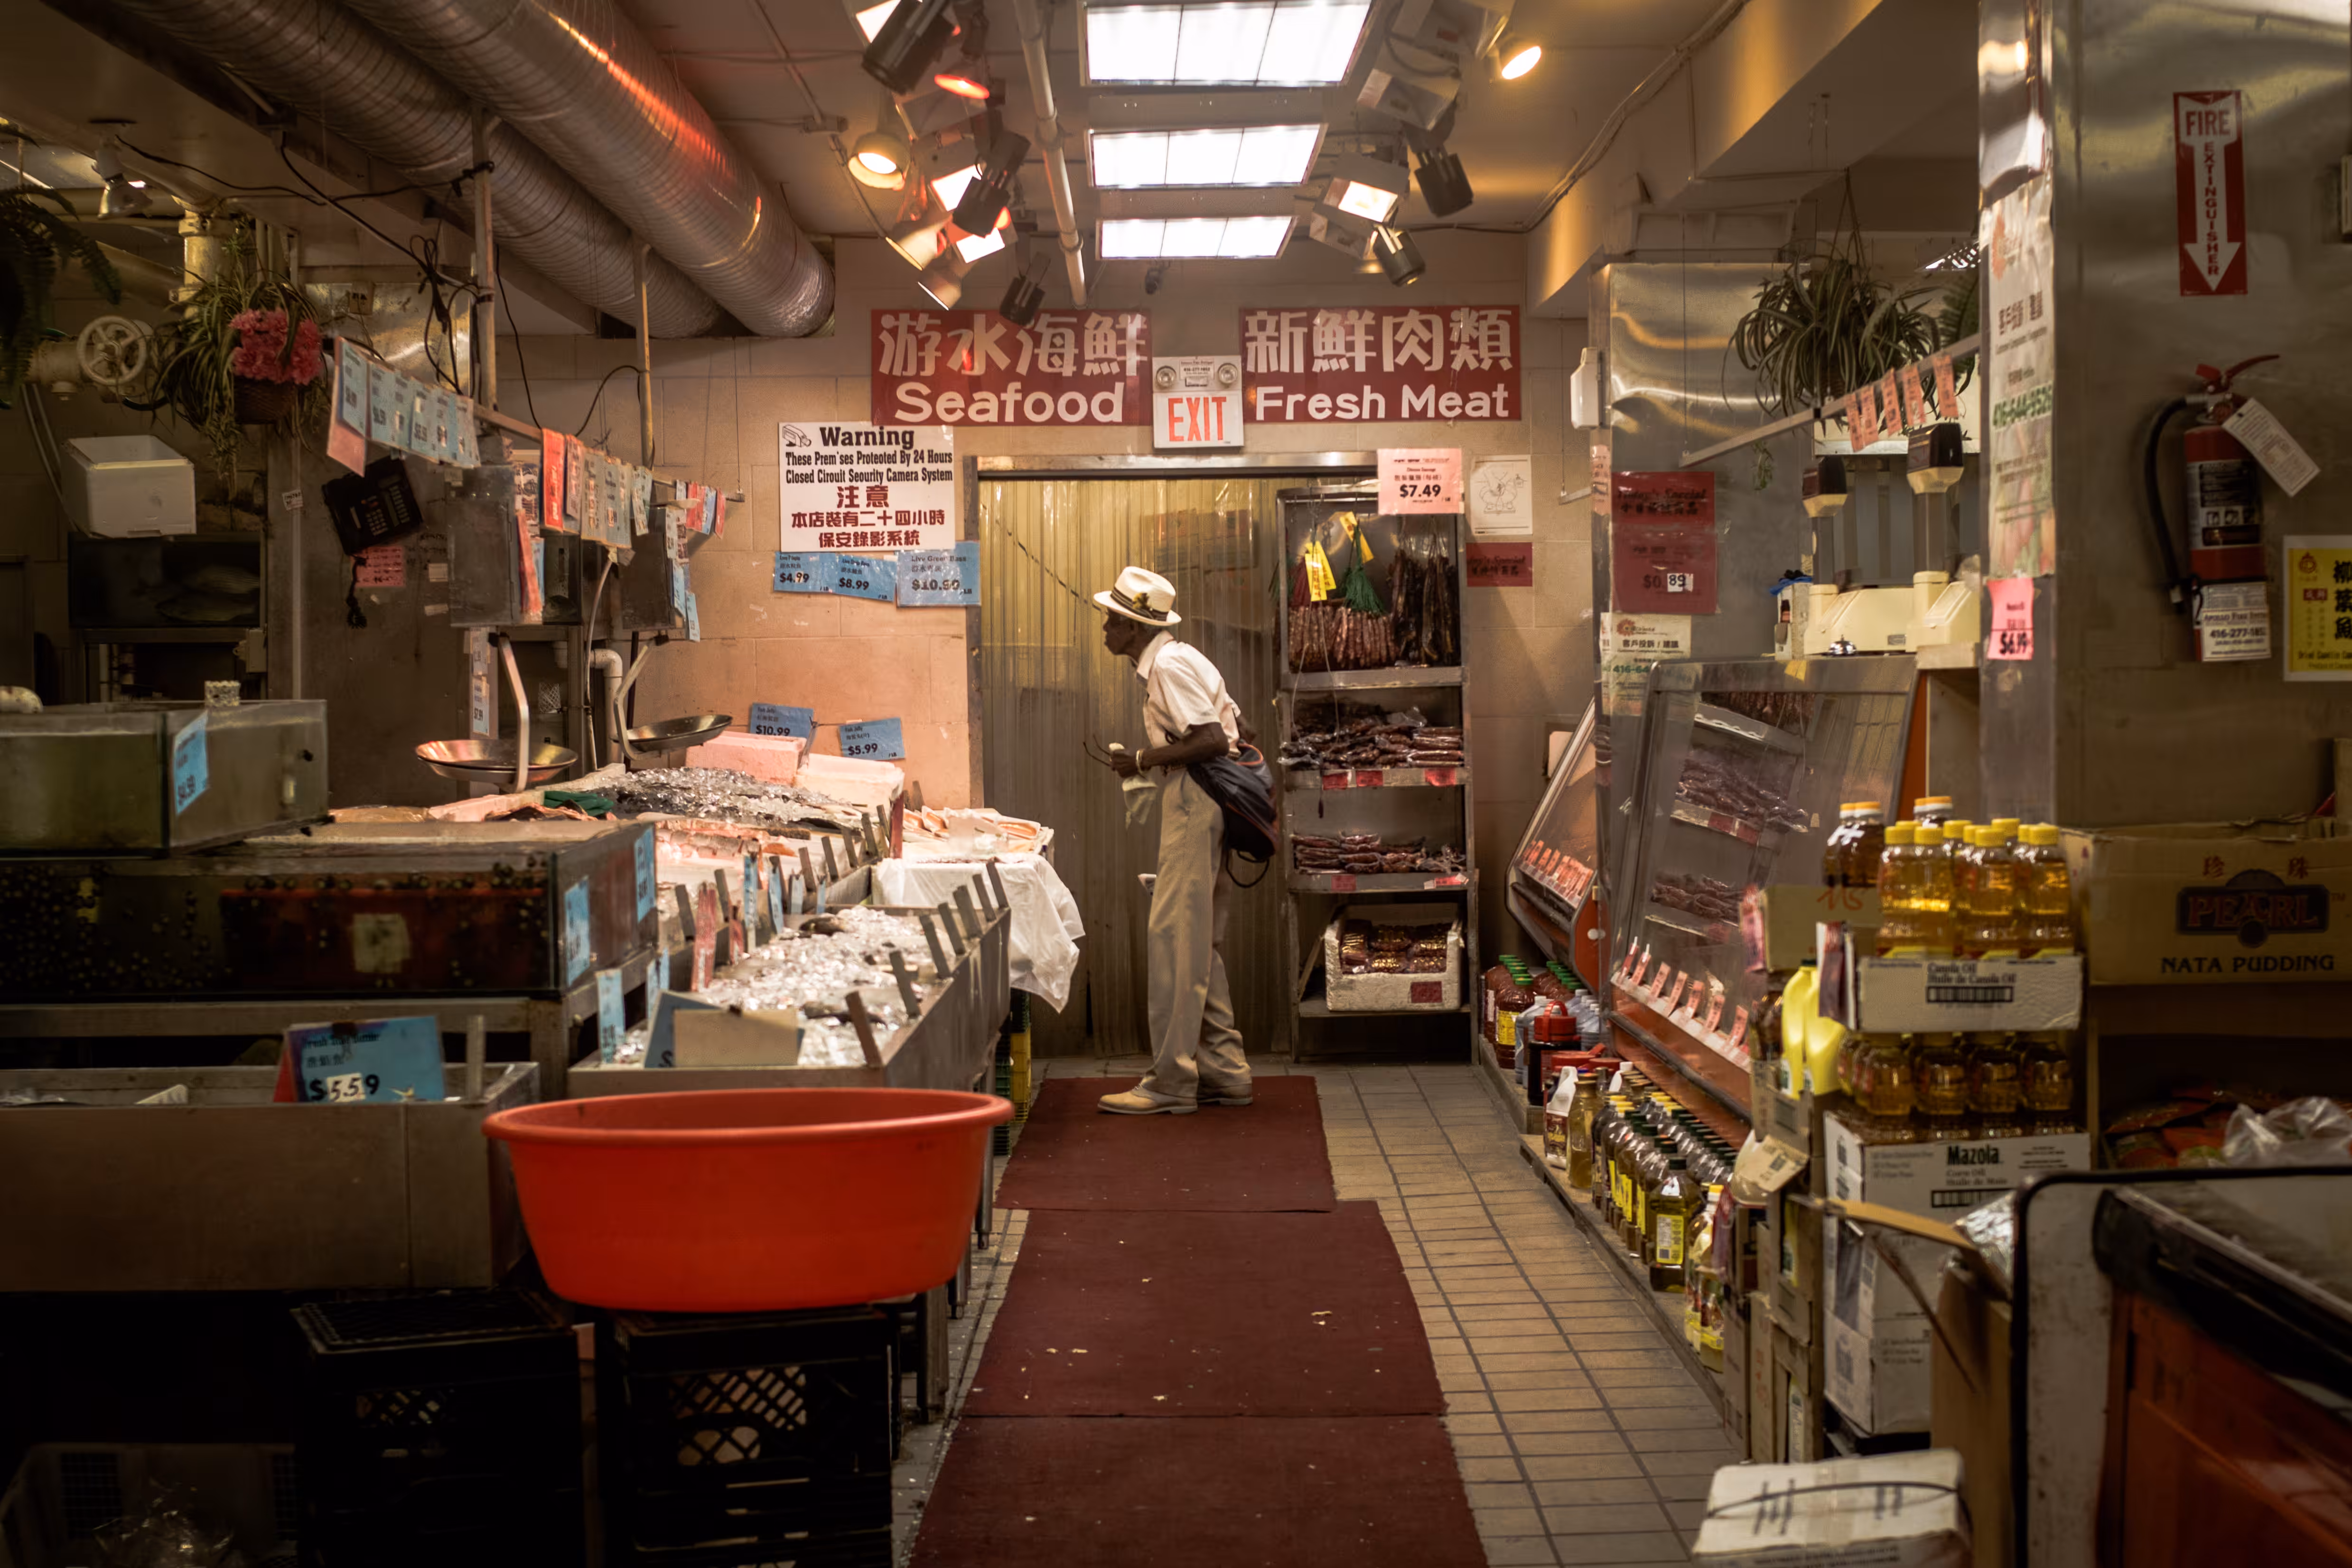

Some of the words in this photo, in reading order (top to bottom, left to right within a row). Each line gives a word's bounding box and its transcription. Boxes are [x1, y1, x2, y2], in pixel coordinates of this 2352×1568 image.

[2185, 109, 2230, 137] FIRE
[2203, 141, 2220, 275] EXTINGUISHER
[878, 312, 1148, 377] 游水海鮮
[1244, 307, 1513, 373] 新鮮肉類
[894, 381, 1125, 423] Seafood
[1255, 384, 1386, 421] Fresh
[1401, 383, 1509, 419] Meat
[1168, 396, 1227, 442] EXIT
[819, 426, 915, 450] Warning
[785, 451, 812, 466] These
[814, 451, 854, 466] Premses
[900, 450, 911, 467] By
[914, 449, 924, 464] 24
[927, 449, 952, 463] Hours
[786, 469, 815, 484] Closed
[887, 468, 919, 482] Camera
[922, 467, 953, 485] System
[837, 485, 889, 509] 注意
[1400, 484, 1441, 498] $7.49
[791, 509, 945, 528] 本店裝有二十四小時
[818, 530, 921, 548] 保安錄影系統
[780, 570, 810, 584] $4.99
[839, 577, 869, 590] $8.99
[912, 579, 960, 591] $10.99
[756, 724, 791, 736] $10.99
[848, 743, 878, 756] $5.99
[2187, 892, 2319, 927] PEARL
[2161, 956, 2223, 974] NATA
[2233, 954, 2335, 973] PUDDING
[1947, 1146, 2000, 1166] Mazola
